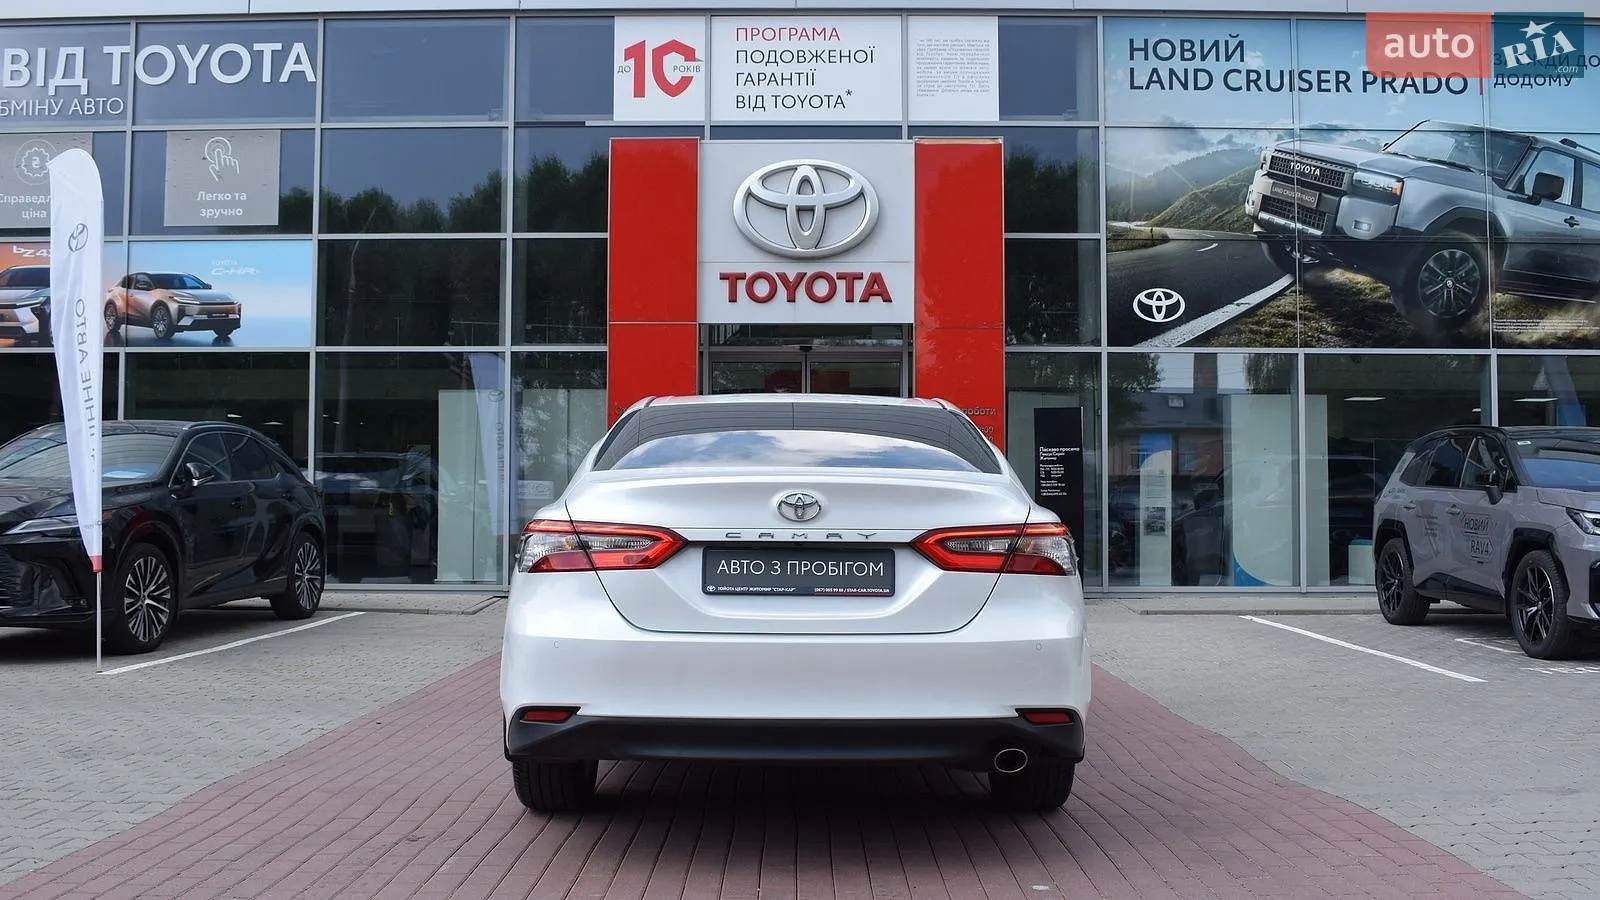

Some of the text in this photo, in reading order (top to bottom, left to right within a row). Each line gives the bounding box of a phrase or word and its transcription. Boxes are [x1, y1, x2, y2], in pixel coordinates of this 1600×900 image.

[736, 27, 841, 42] ПРОГРАМА
[736, 46, 876, 67] ПОДОВЖЕНОЇ
[1129, 33, 1245, 63] НОВИЙ
[2, 42, 317, 95] ВІД TOYOTA
[617, 40, 701, 97] ДО 10 РОКІВ
[736, 68, 817, 87] ГАРАНТІЇ
[1129, 67, 1469, 95] LAND CRUISER PRADO
[1493, 73, 1574, 88] ДОДОМУ
[68, 97, 124, 116] АВТО
[736, 95, 766, 112] ВІД
[1290, 162, 1320, 176] TOYOTA
[197, 191, 247, 201] Легко та
[22, 208, 47, 220] ціна
[200, 208, 243, 219] зручно
[12, 245, 51, 258] bZ4
[719, 271, 893, 304] TOYOTA
[725, 532, 877, 540] CAMRY
[1470, 540, 1489, 554] RAV4
[717, 560, 884, 577] АВТО З ПРОБІГОМ
